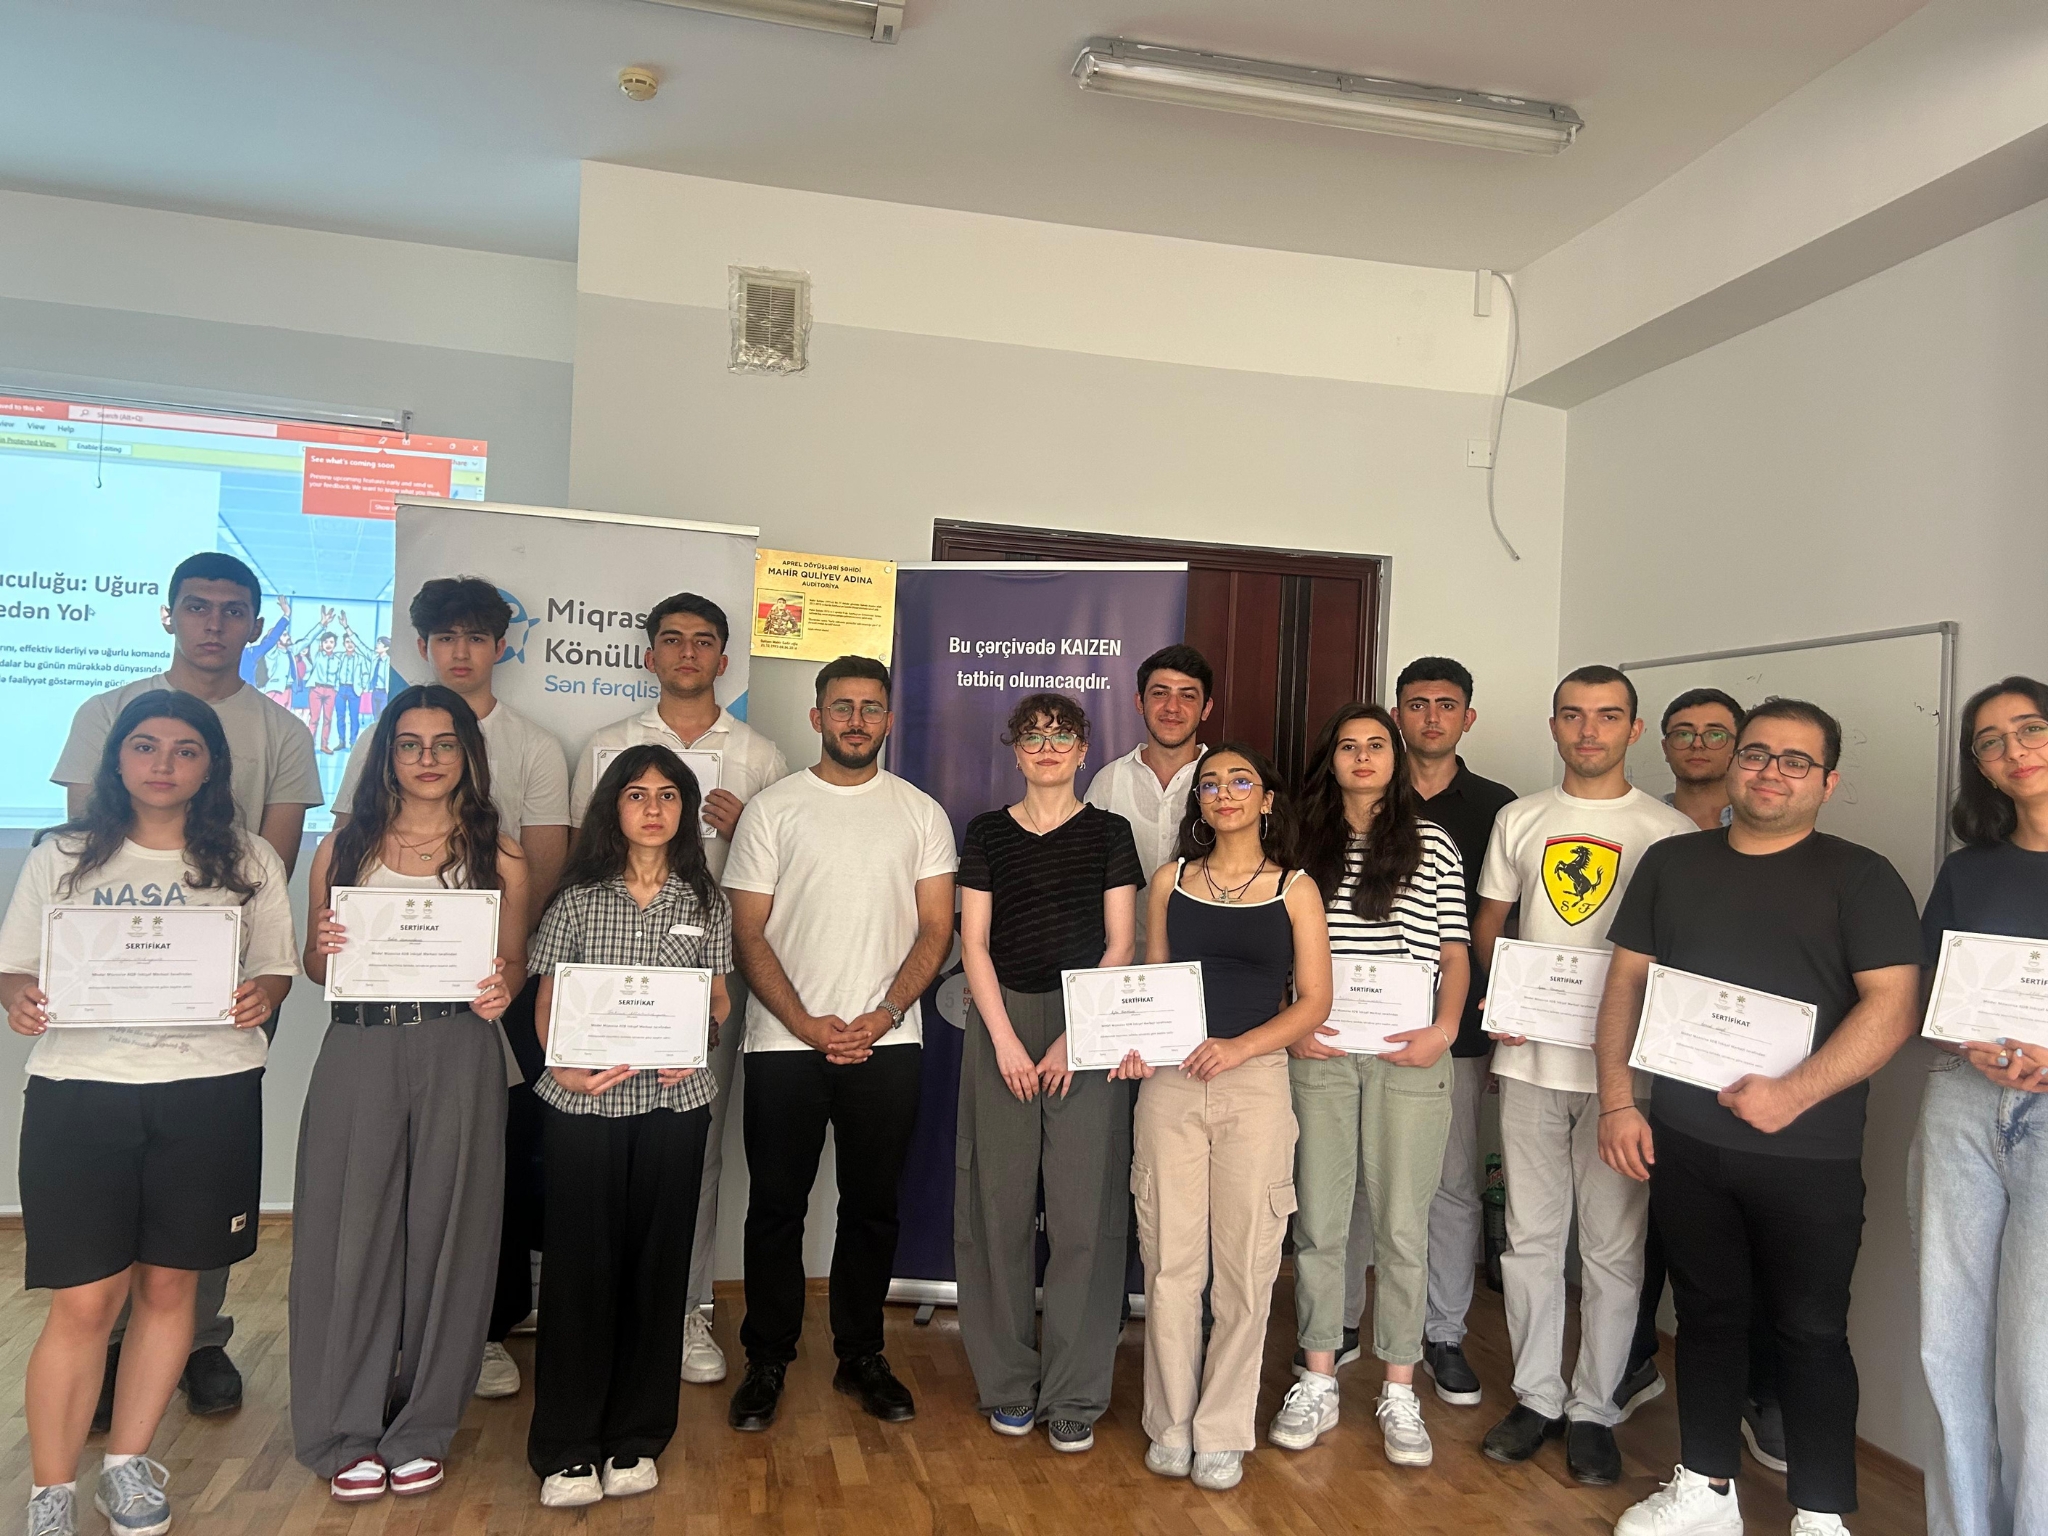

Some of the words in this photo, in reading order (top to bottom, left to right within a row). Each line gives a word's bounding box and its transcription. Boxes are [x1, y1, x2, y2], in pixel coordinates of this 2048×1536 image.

[27, 422, 45, 430] View
[57, 424, 75, 434] Help
[7, 437, 38, 446] Protected
[76, 442, 99, 451] Enable
[310, 455, 325, 463] See
[325, 456, 348, 465] what's
[349, 459, 377, 469] coming
[452, 459, 468, 467] hare
[309, 472, 333, 481] Preview
[332, 475, 362, 485] upcoming
[362, 477, 386, 486] features
[768, 567, 798, 578] MAHİR
[801, 571, 841, 582] QULİYEV
[843, 575, 873, 585] ADINA
[95, 575, 159, 597] Uğura
[802, 580, 839, 589] AUDİTORİYA
[57, 603, 89, 621] Yol
[19, 644, 53, 653] effektiv
[54, 645, 87, 656] liderliyi
[88, 648, 99, 656] və
[101, 647, 129, 657] uğurlu
[131, 649, 171, 659] komanda
[949, 636, 971, 653] Bu
[977, 637, 1056, 658] çərçivədə
[1060, 639, 1122, 656] KAIZEN
[24, 660, 36, 669] bu
[37, 661, 66, 671] günün
[544, 675, 585, 694] Sən
[957, 670, 1004, 690] tətbiq
[1009, 671, 1111, 692] olunacaqdır.
[93, 882, 187, 906] NASA
[125, 942, 171, 950] SERTİFİKAT
[1550, 976, 1583, 985] SERTİFİKAT
[1711, 1013, 1750, 1027] SERTİFİKAT
